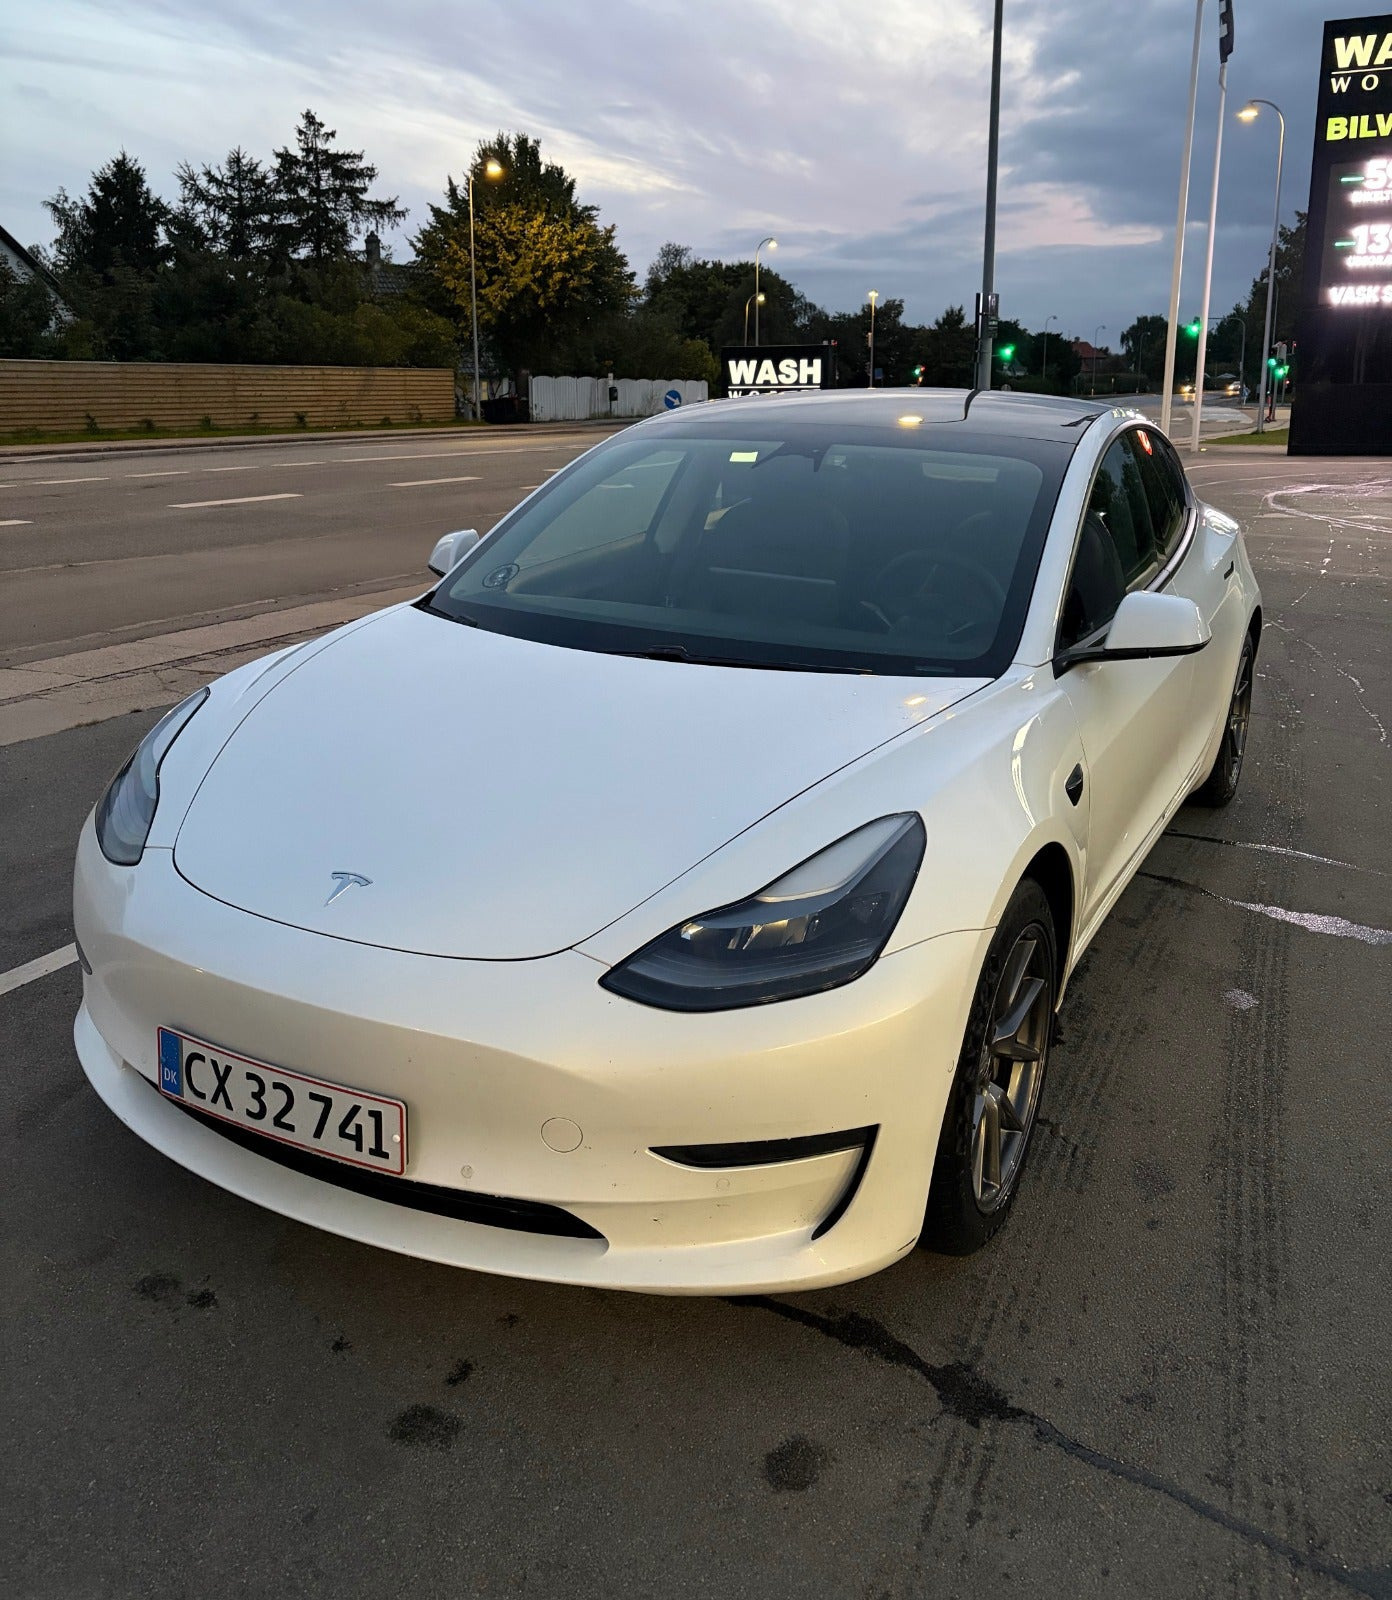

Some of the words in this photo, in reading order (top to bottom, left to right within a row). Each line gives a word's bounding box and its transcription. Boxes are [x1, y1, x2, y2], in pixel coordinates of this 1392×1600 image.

[1363, 159, 1392, 189] 5
[1352, 224, 1392, 254] 13
[1329, 286, 1380, 305] VASK
[728, 358, 822, 385] WASH
[164, 1067, 178, 1085] DK
[184, 1051, 234, 1111] CX
[245, 1071, 296, 1133] 32
[308, 1091, 390, 1160] 741
